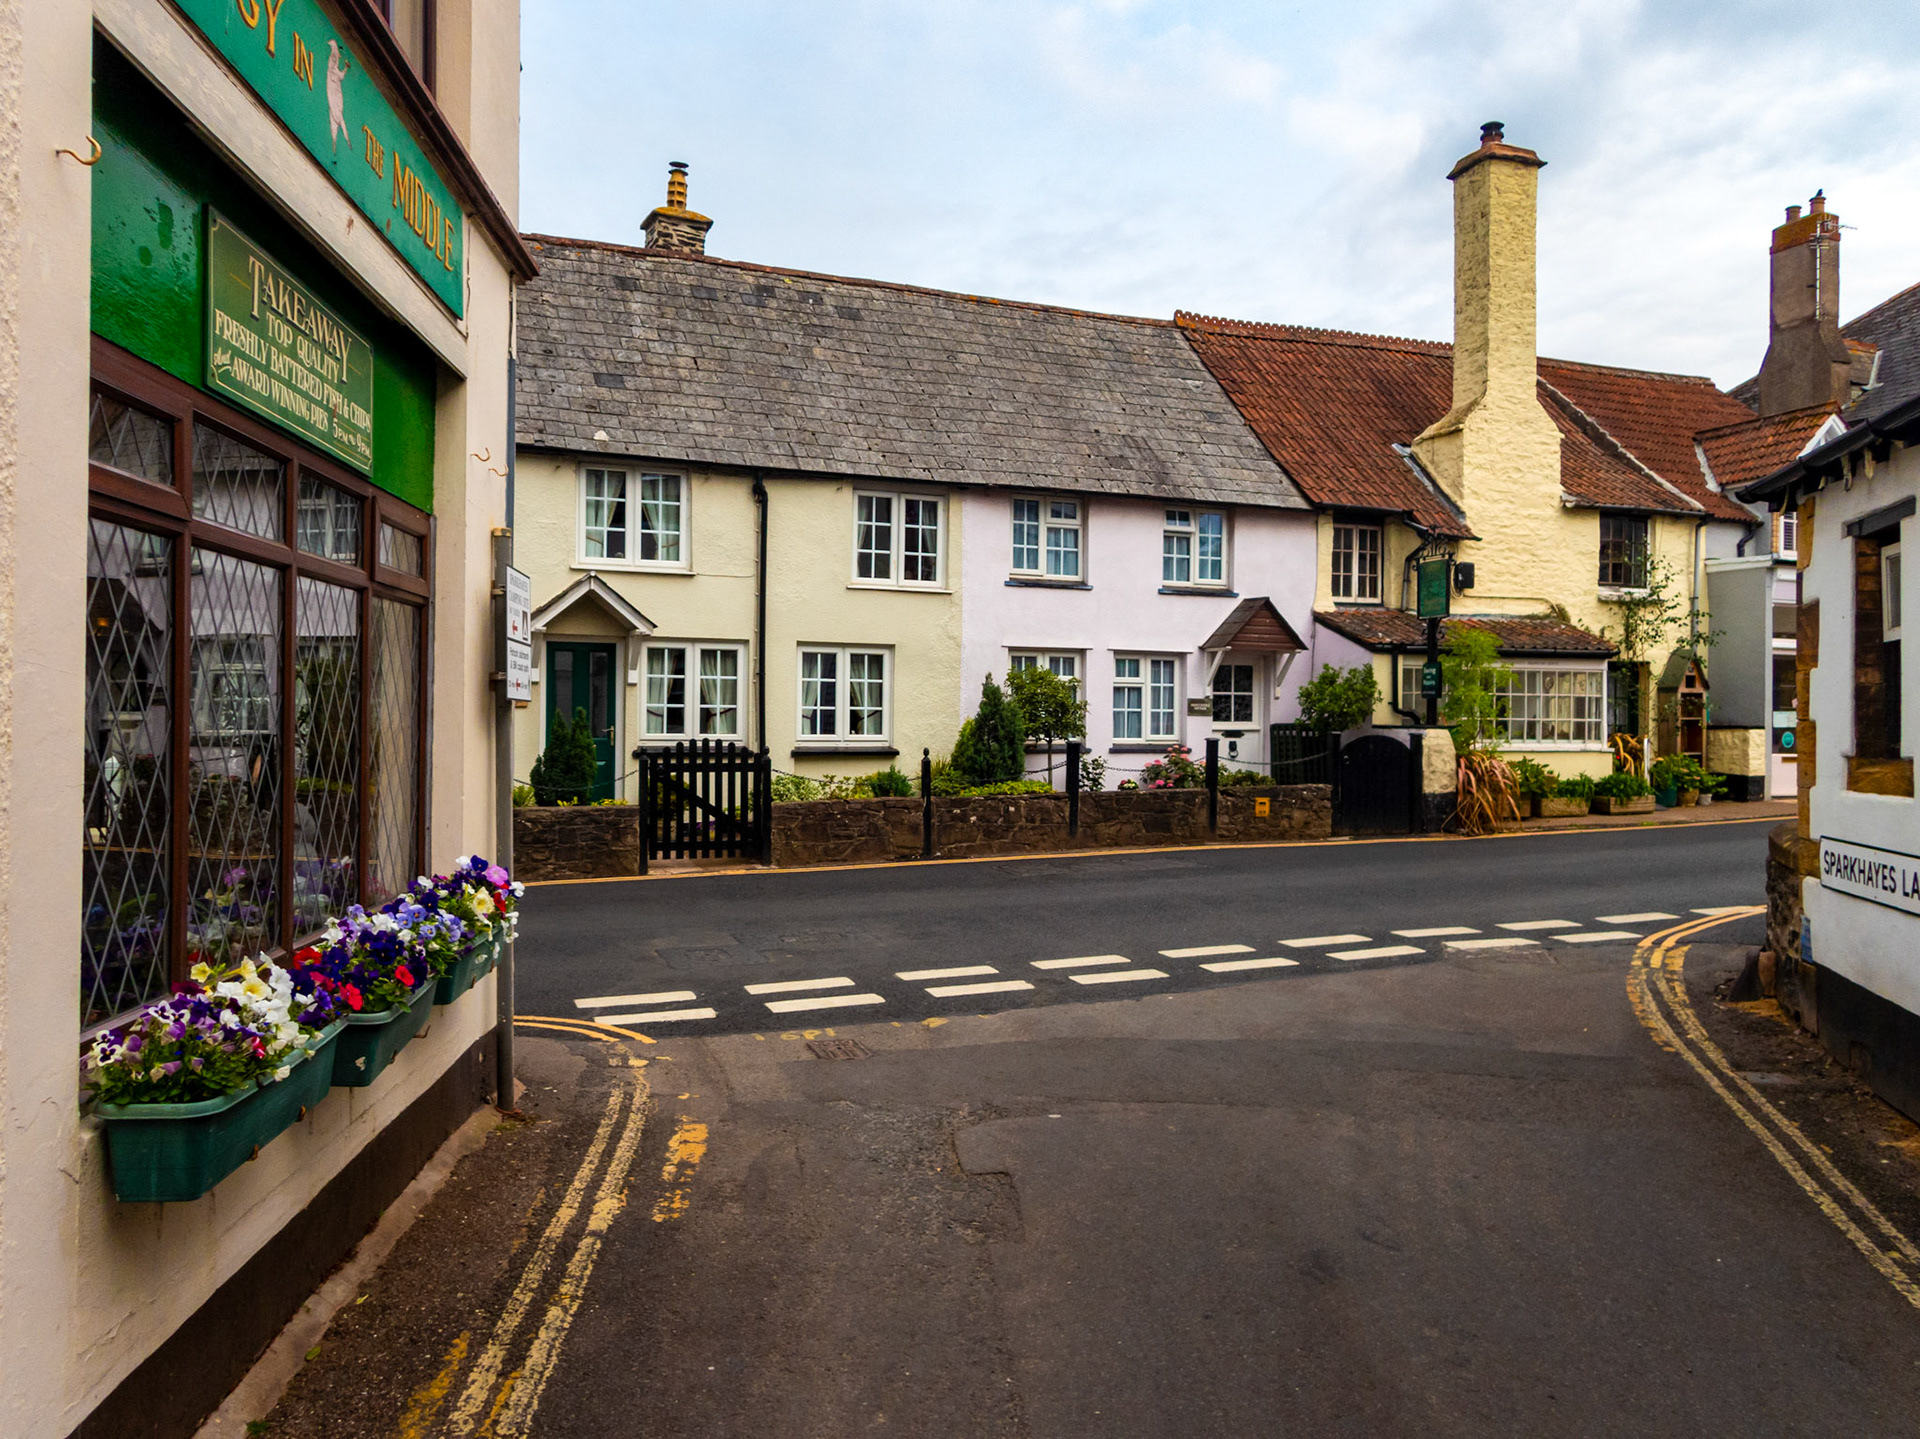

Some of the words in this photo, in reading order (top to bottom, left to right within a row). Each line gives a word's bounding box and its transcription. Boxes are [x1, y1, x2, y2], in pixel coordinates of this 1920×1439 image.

[293, 31, 314, 91] IN
[362, 124, 385, 180] THE
[391, 150, 455, 271] MIDDLE
[248, 255, 353, 385] TAKEAWAY
[266, 311, 293, 348] TOP
[296, 335, 340, 384] QUALITY
[215, 308, 269, 365] FRESHLY
[270, 345, 322, 401] BATTERED
[323, 382, 343, 415] FISH
[343, 398, 350, 419] &
[350, 401, 372, 433] CHIPS
[230, 356, 270, 397] AWARD
[270, 377, 310, 421] WINNING
[310, 403, 329, 432] PIES
[1823, 849, 1897, 894] SPARKHAYES
